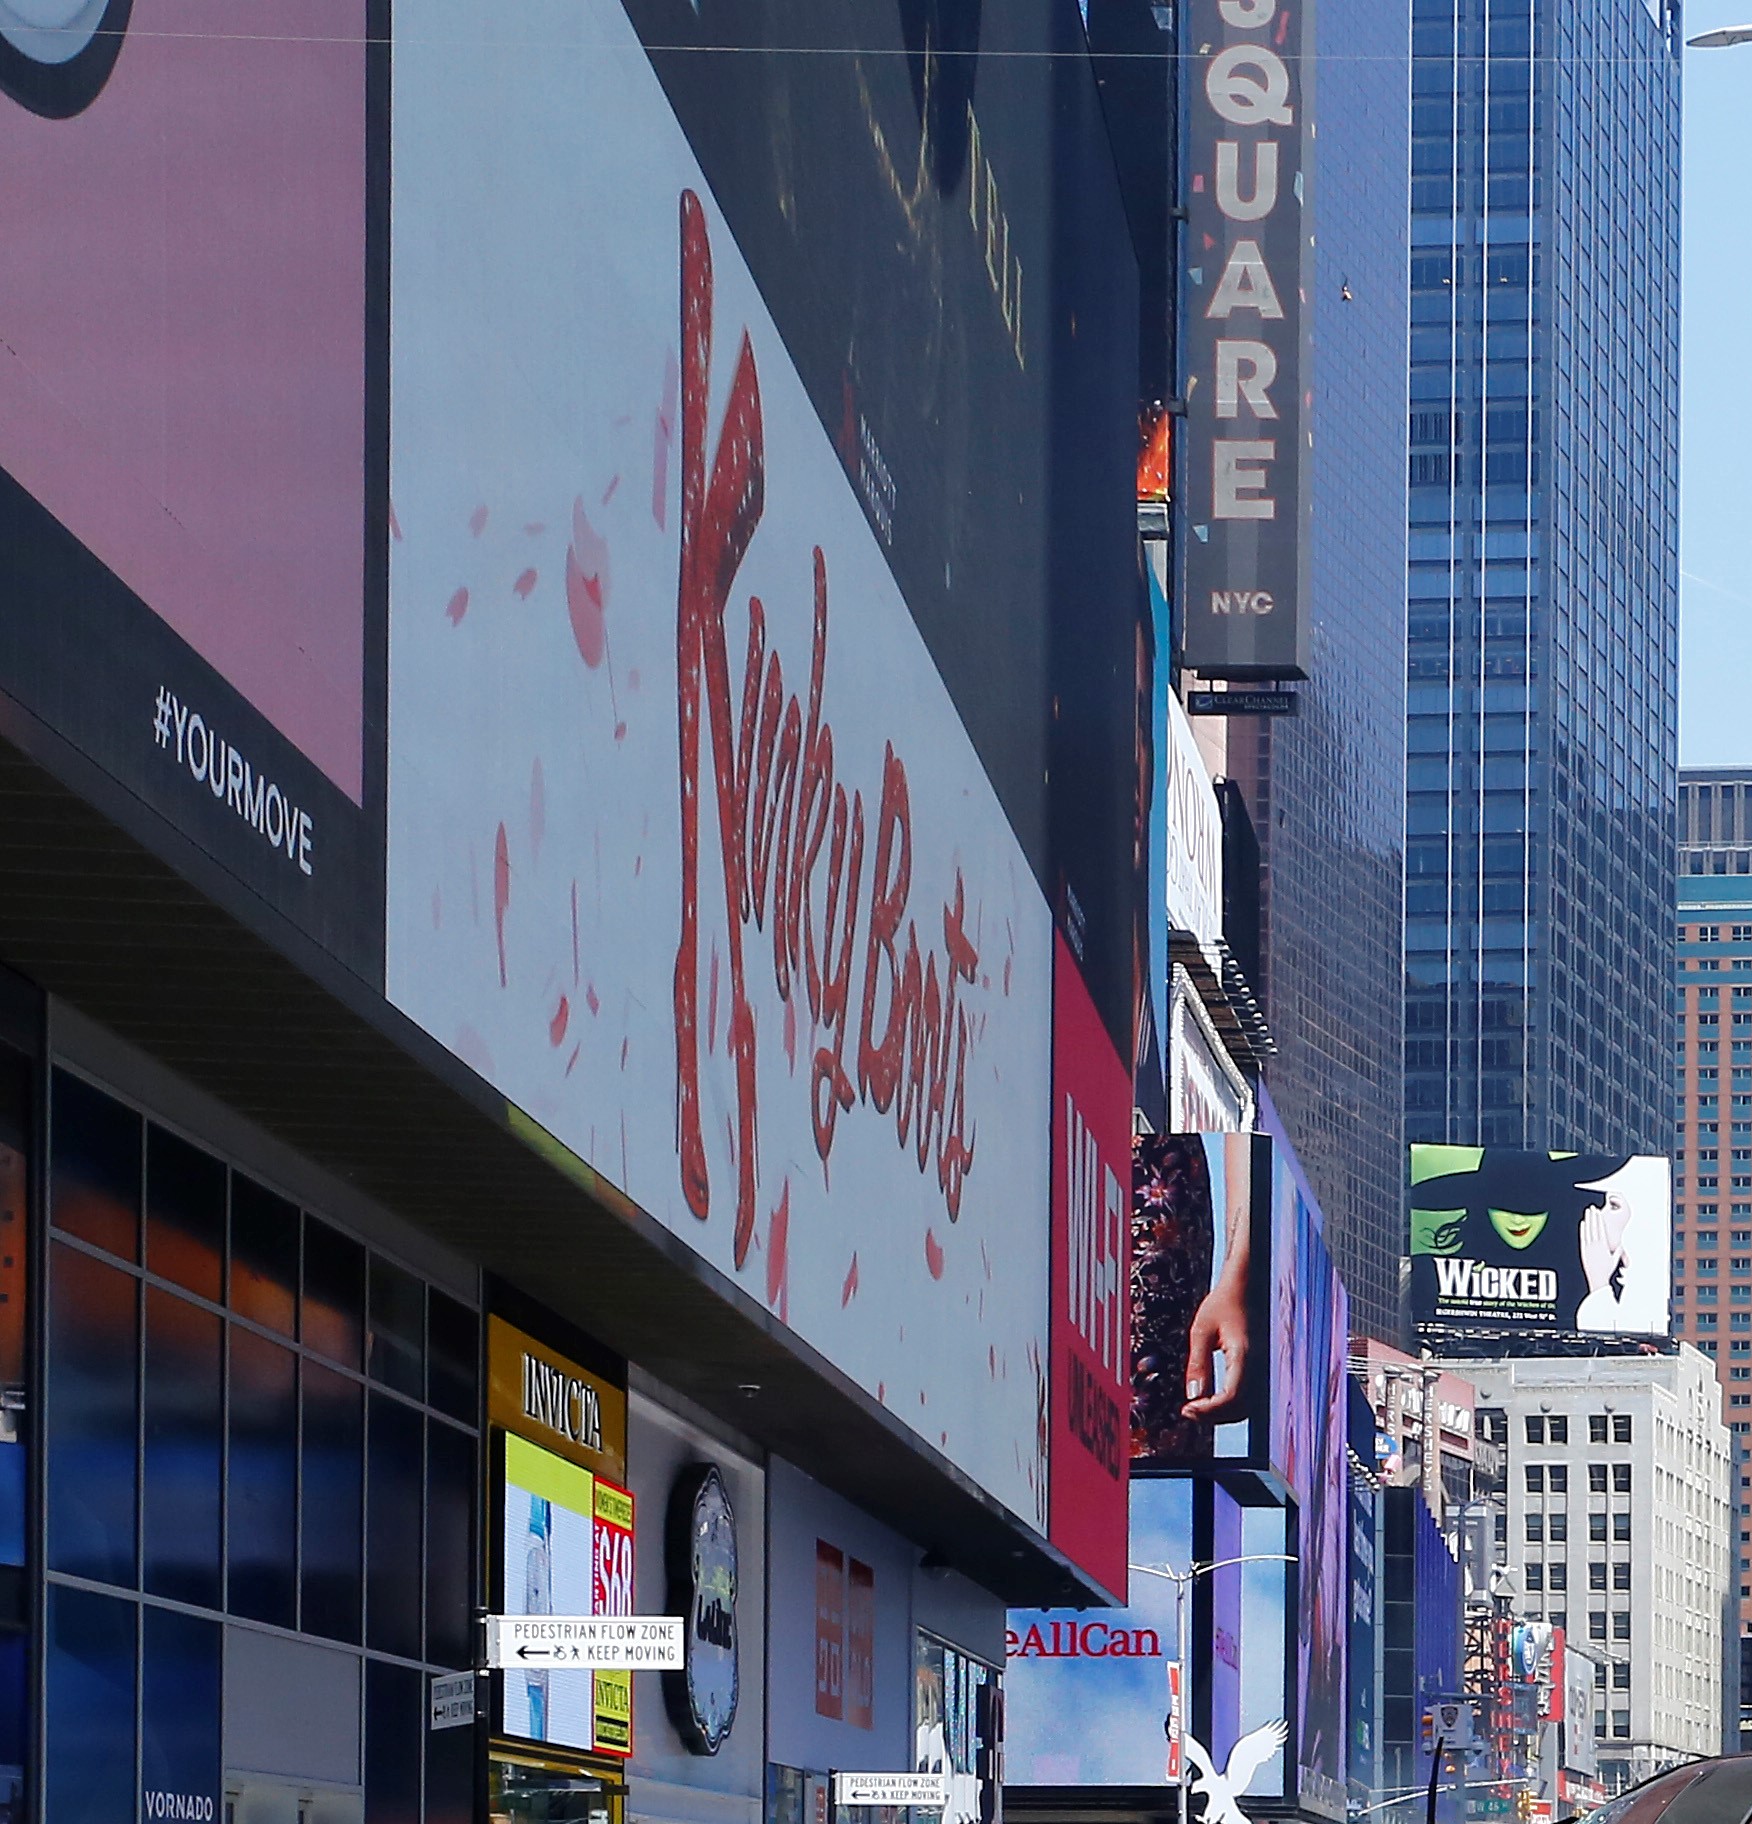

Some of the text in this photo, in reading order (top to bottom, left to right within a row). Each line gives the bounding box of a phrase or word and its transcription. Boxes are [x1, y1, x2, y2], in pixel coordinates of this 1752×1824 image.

[966, 98, 1025, 373] TELL
[1210, 591, 1274, 615] NYC
[152, 685, 313, 877] #YOURMOVE
[520, 1351, 602, 1453] INVICTA
[514, 1623, 675, 1640] PEDESTRIAN FLOW ZONE
[586, 1645, 675, 1661] KEEP MOVING
[850, 1777, 941, 1789] PEDESTRIAN FLOW ZONE
[145, 1790, 214, 1822] VORNADO
[890, 1790, 941, 1801] KEEP MOVING
